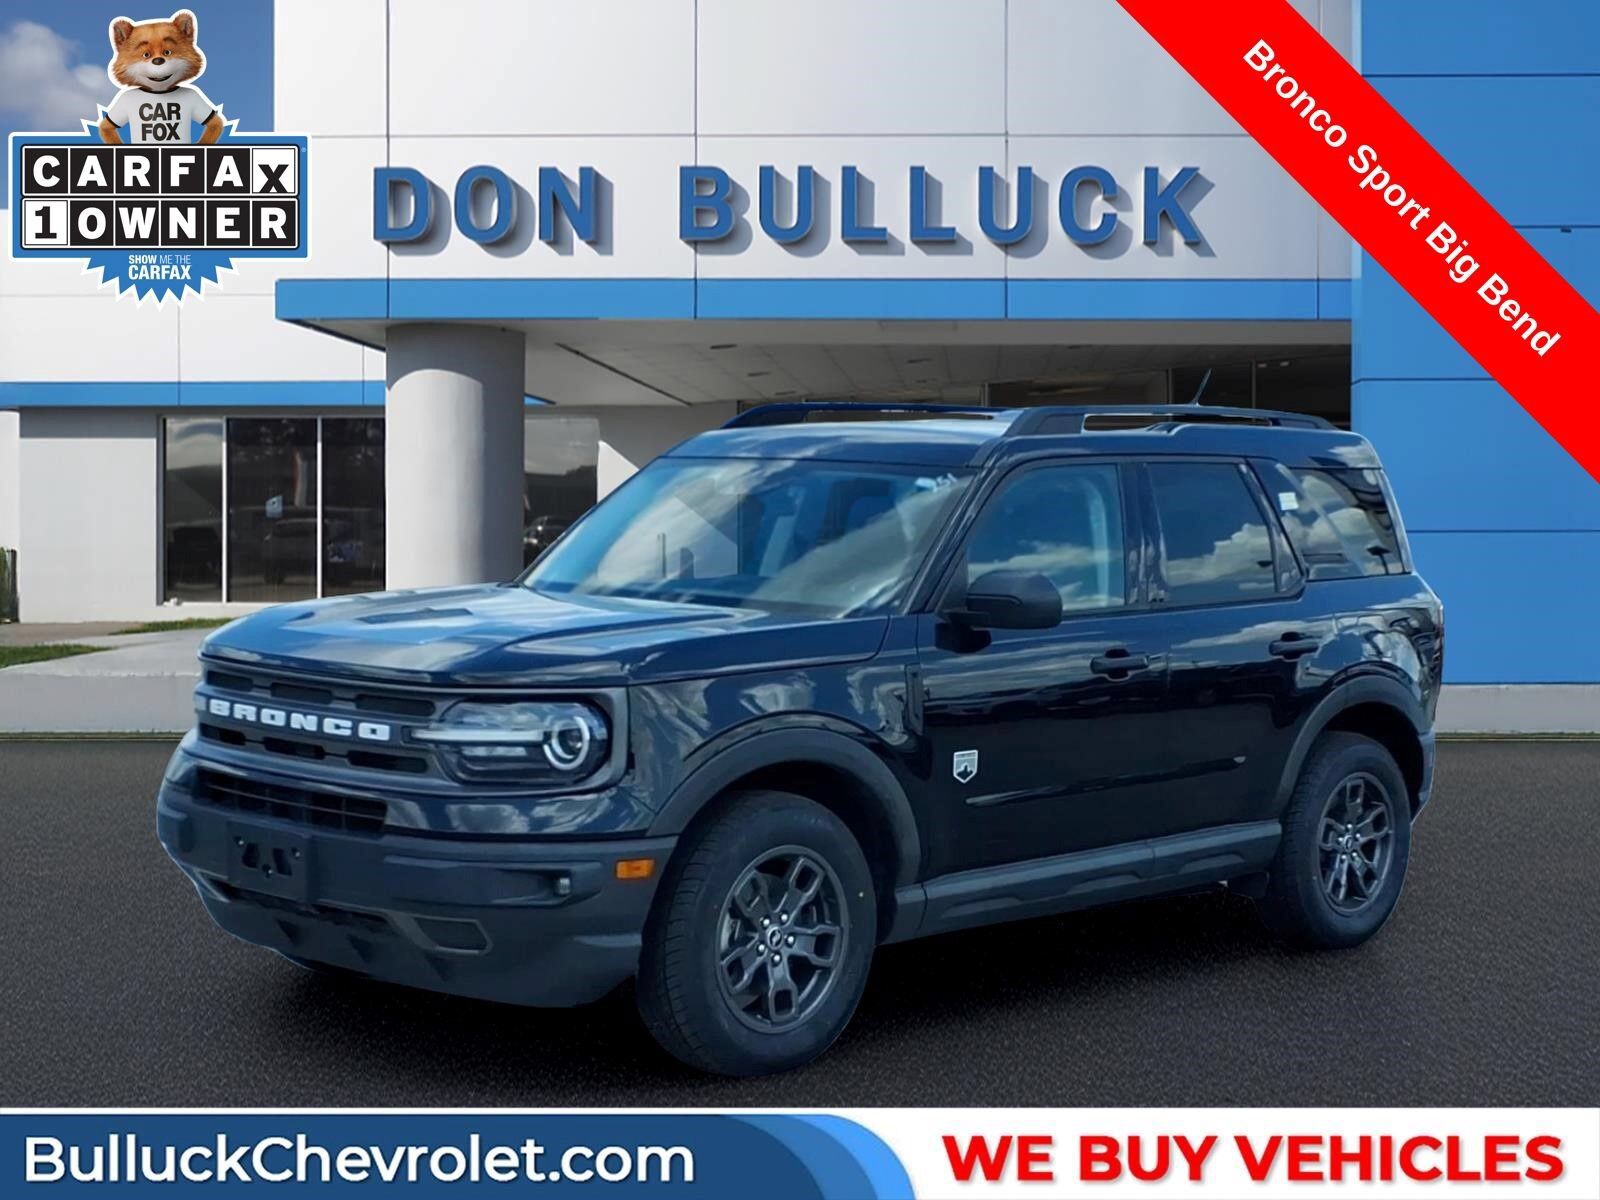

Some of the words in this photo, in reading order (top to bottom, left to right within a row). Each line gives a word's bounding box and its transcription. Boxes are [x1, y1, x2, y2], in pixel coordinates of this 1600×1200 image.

[374, 165, 597, 243] DON
[679, 164, 1201, 244] BULLUCK
[208, 698, 391, 741] BRONCO
